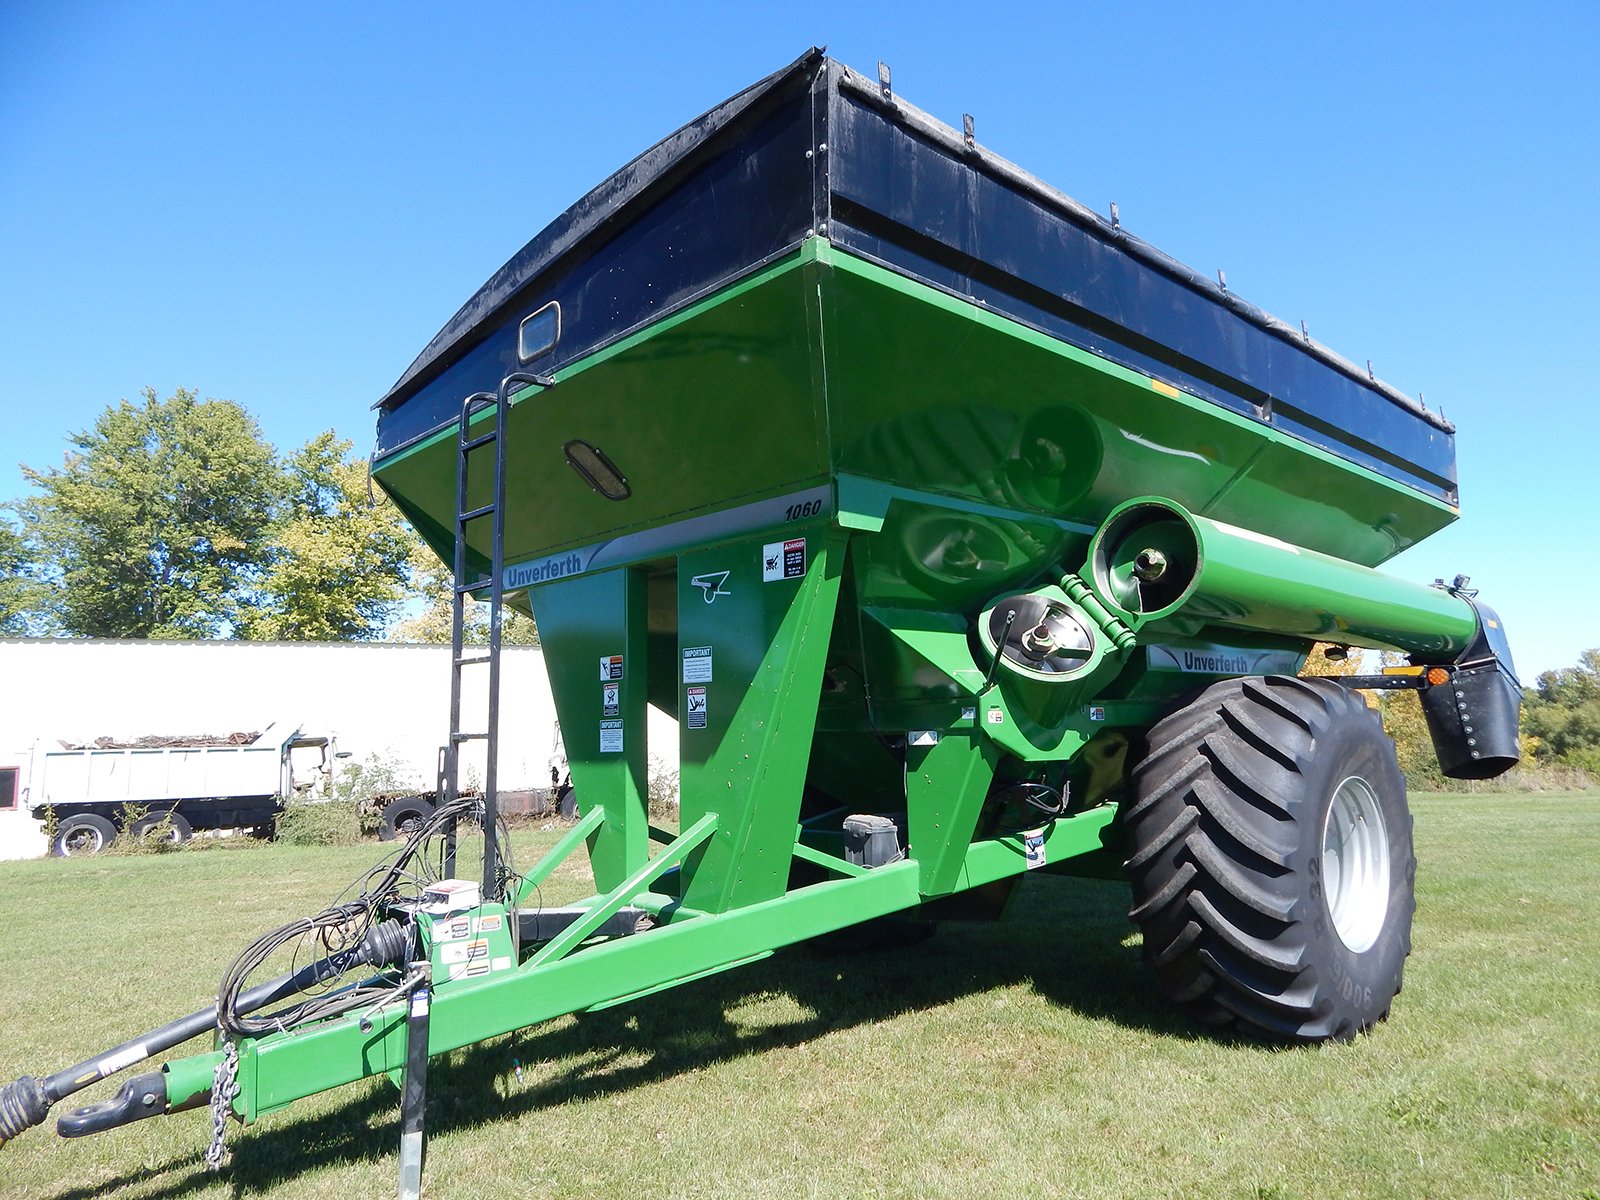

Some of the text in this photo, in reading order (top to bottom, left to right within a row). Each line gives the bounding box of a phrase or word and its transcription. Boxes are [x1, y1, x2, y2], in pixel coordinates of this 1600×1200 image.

[785, 499, 822, 522] 1060
[508, 552, 581, 587] Unverferth
[684, 648, 711, 658] IMPORTANT
[1184, 652, 1248, 673] Unverferth
